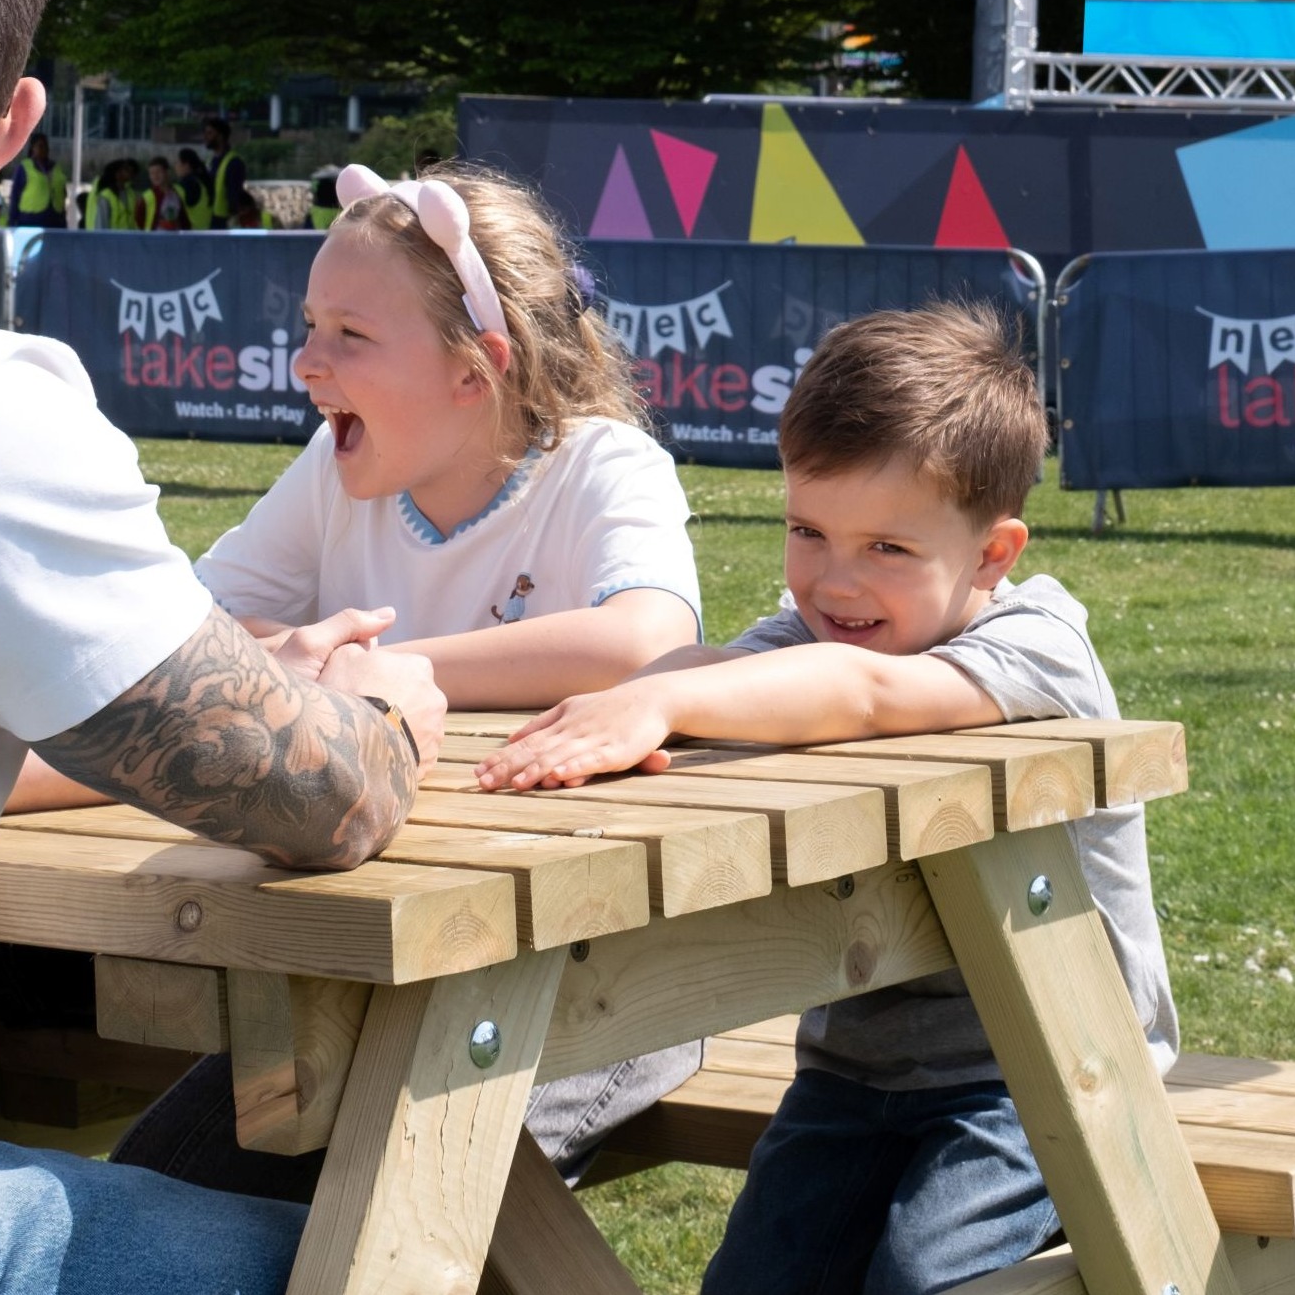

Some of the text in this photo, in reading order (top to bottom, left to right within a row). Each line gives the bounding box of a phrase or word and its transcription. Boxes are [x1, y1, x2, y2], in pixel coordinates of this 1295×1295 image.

[125, 289, 209, 322] nec
[614, 303, 716, 339] nec
[123, 328, 308, 392] lakesi
[176, 401, 305, 425] Watch Eat Play
[672, 423, 779, 444] Watch Eat
